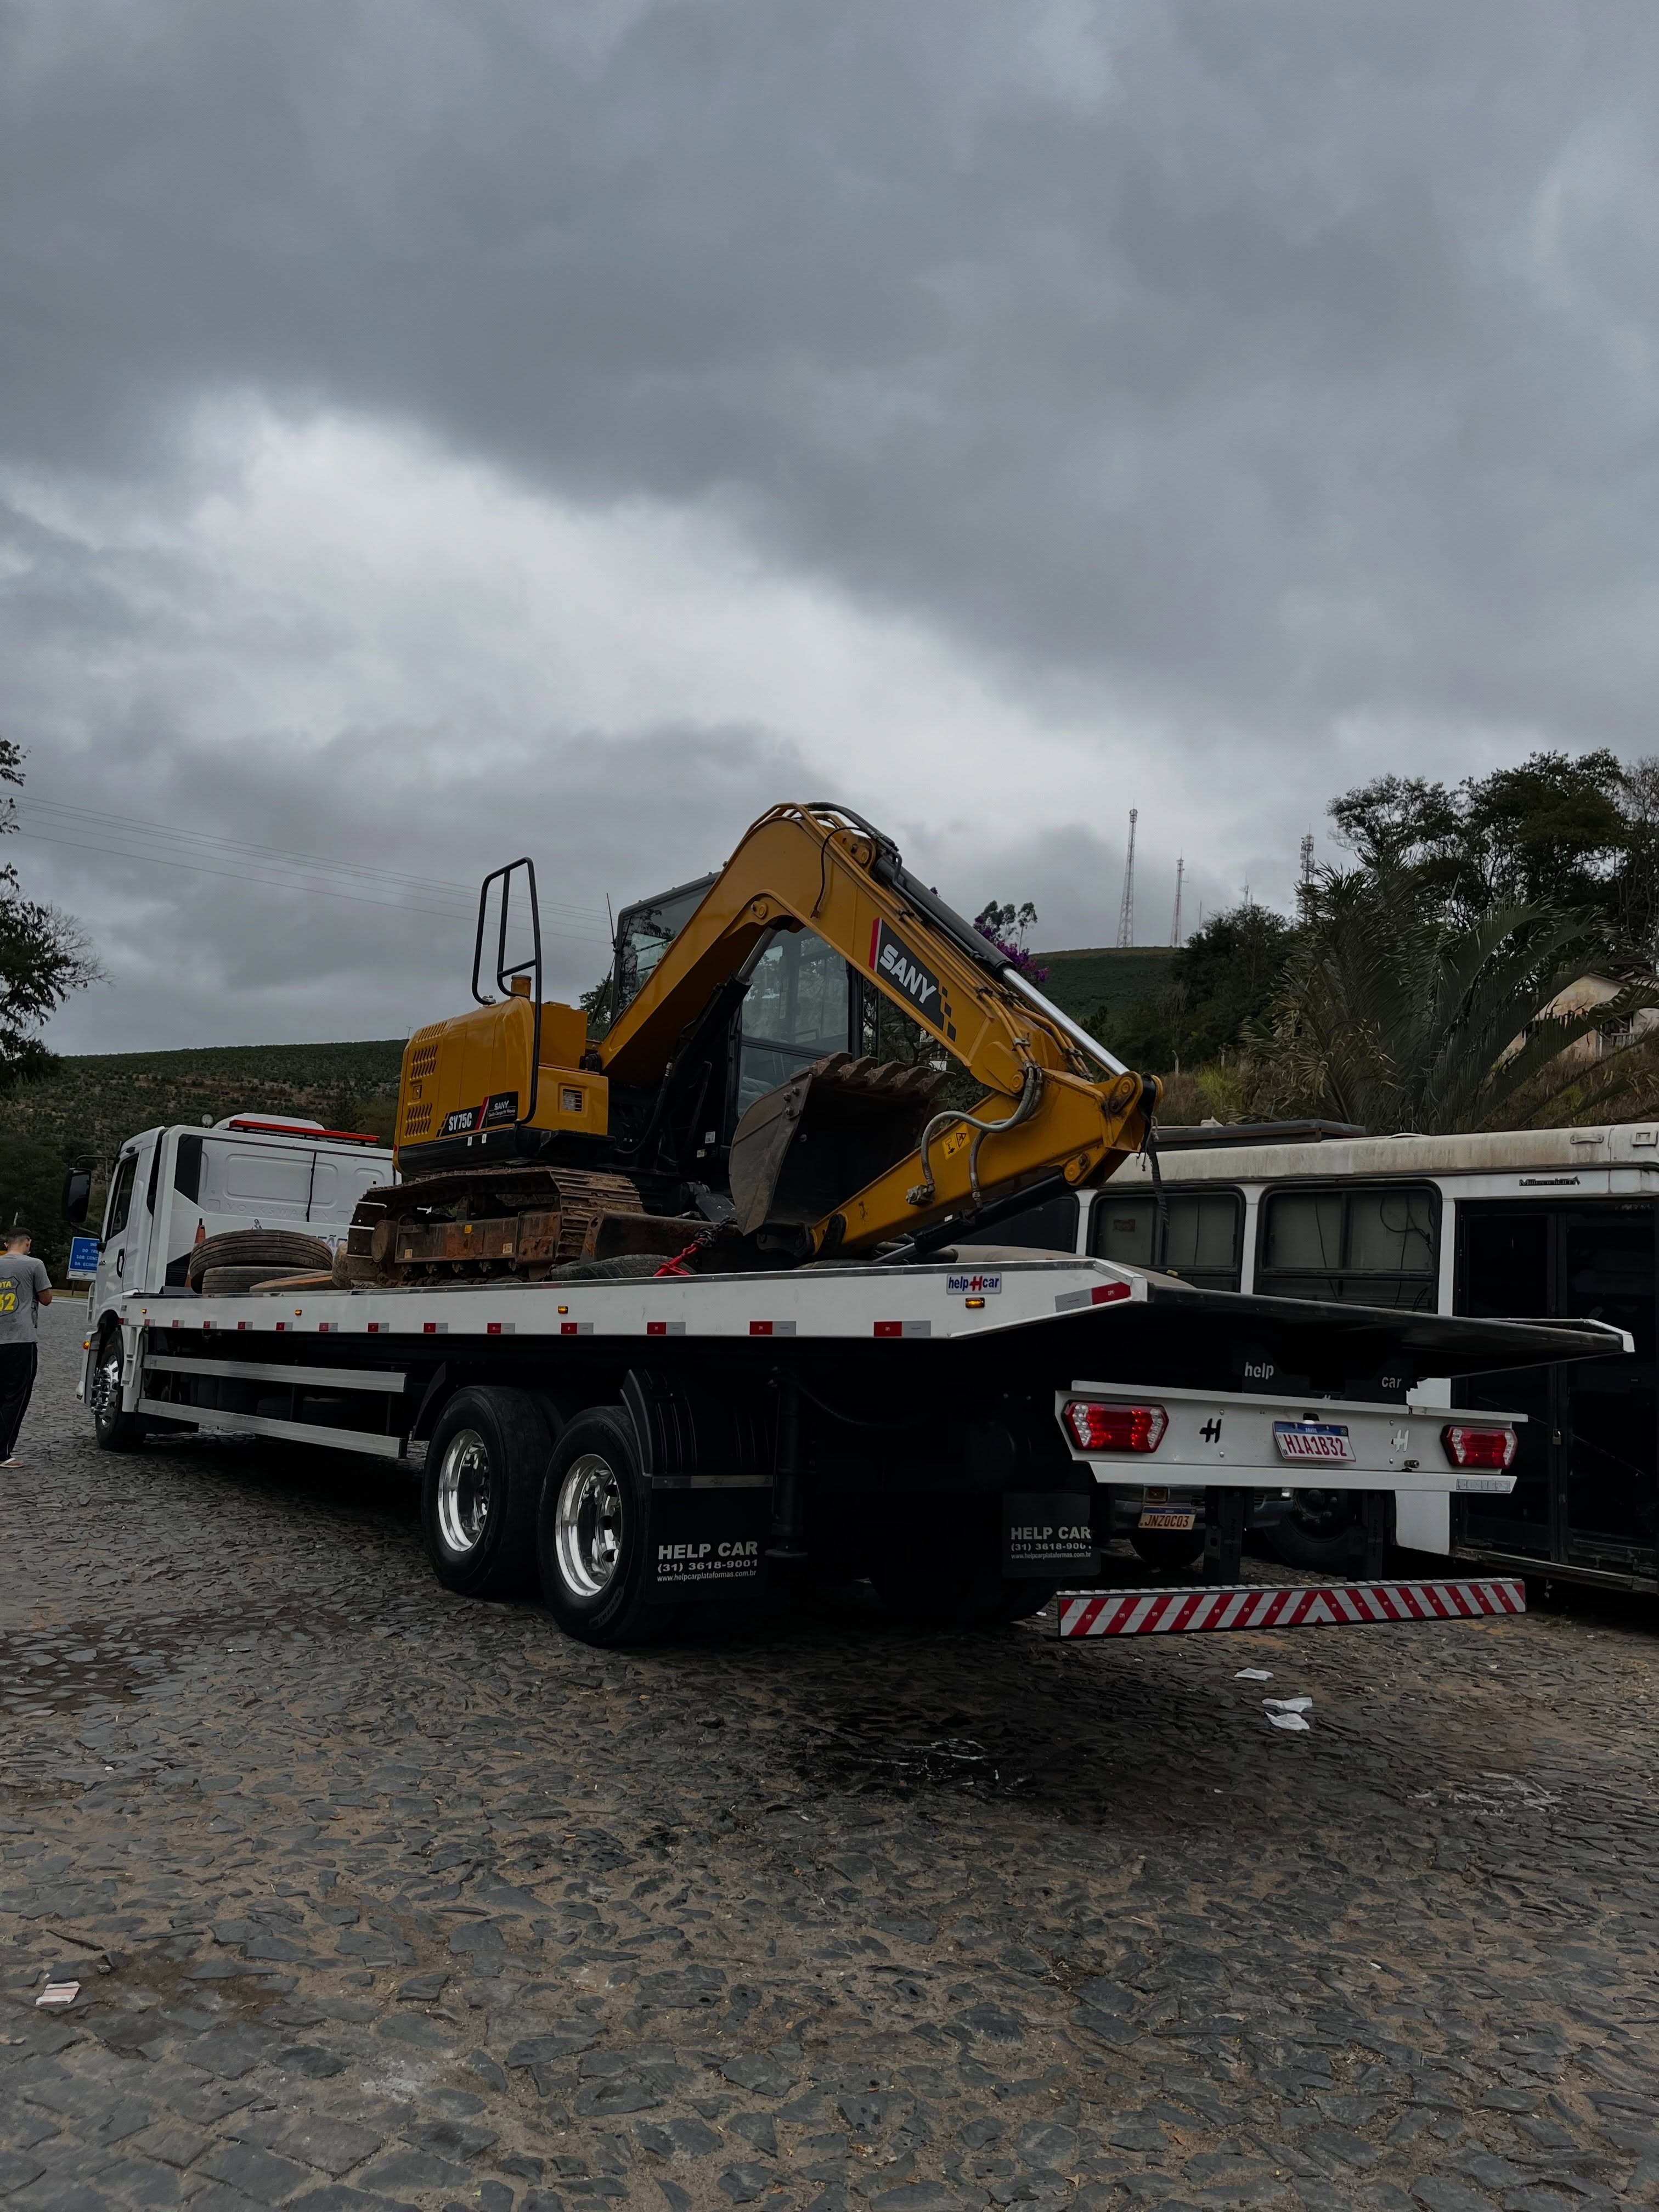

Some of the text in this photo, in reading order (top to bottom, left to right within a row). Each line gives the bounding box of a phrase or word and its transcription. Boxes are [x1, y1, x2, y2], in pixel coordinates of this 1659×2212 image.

[879, 944, 937, 1004] SANY
[494, 1100, 510, 1110] SANY
[448, 1112, 472, 1131] SY75C
[948, 1276, 969, 1291] help
[983, 1278, 999, 1288] car
[1244, 1361, 1402, 1389] help car
[1283, 1434, 1347, 1457] HIA1B32
[1010, 1526, 1092, 1540] HELP CAR
[658, 1541, 758, 1560] HELP CAR
[1011, 1542, 1032, 1552] (31)
[1010, 1551, 1091, 1561] www.helpcarplataformas.com.br
[657, 1559, 758, 1573] (31) 3618-9001
[657, 1569, 757, 1582] www.helpcarplataformas.com.br
